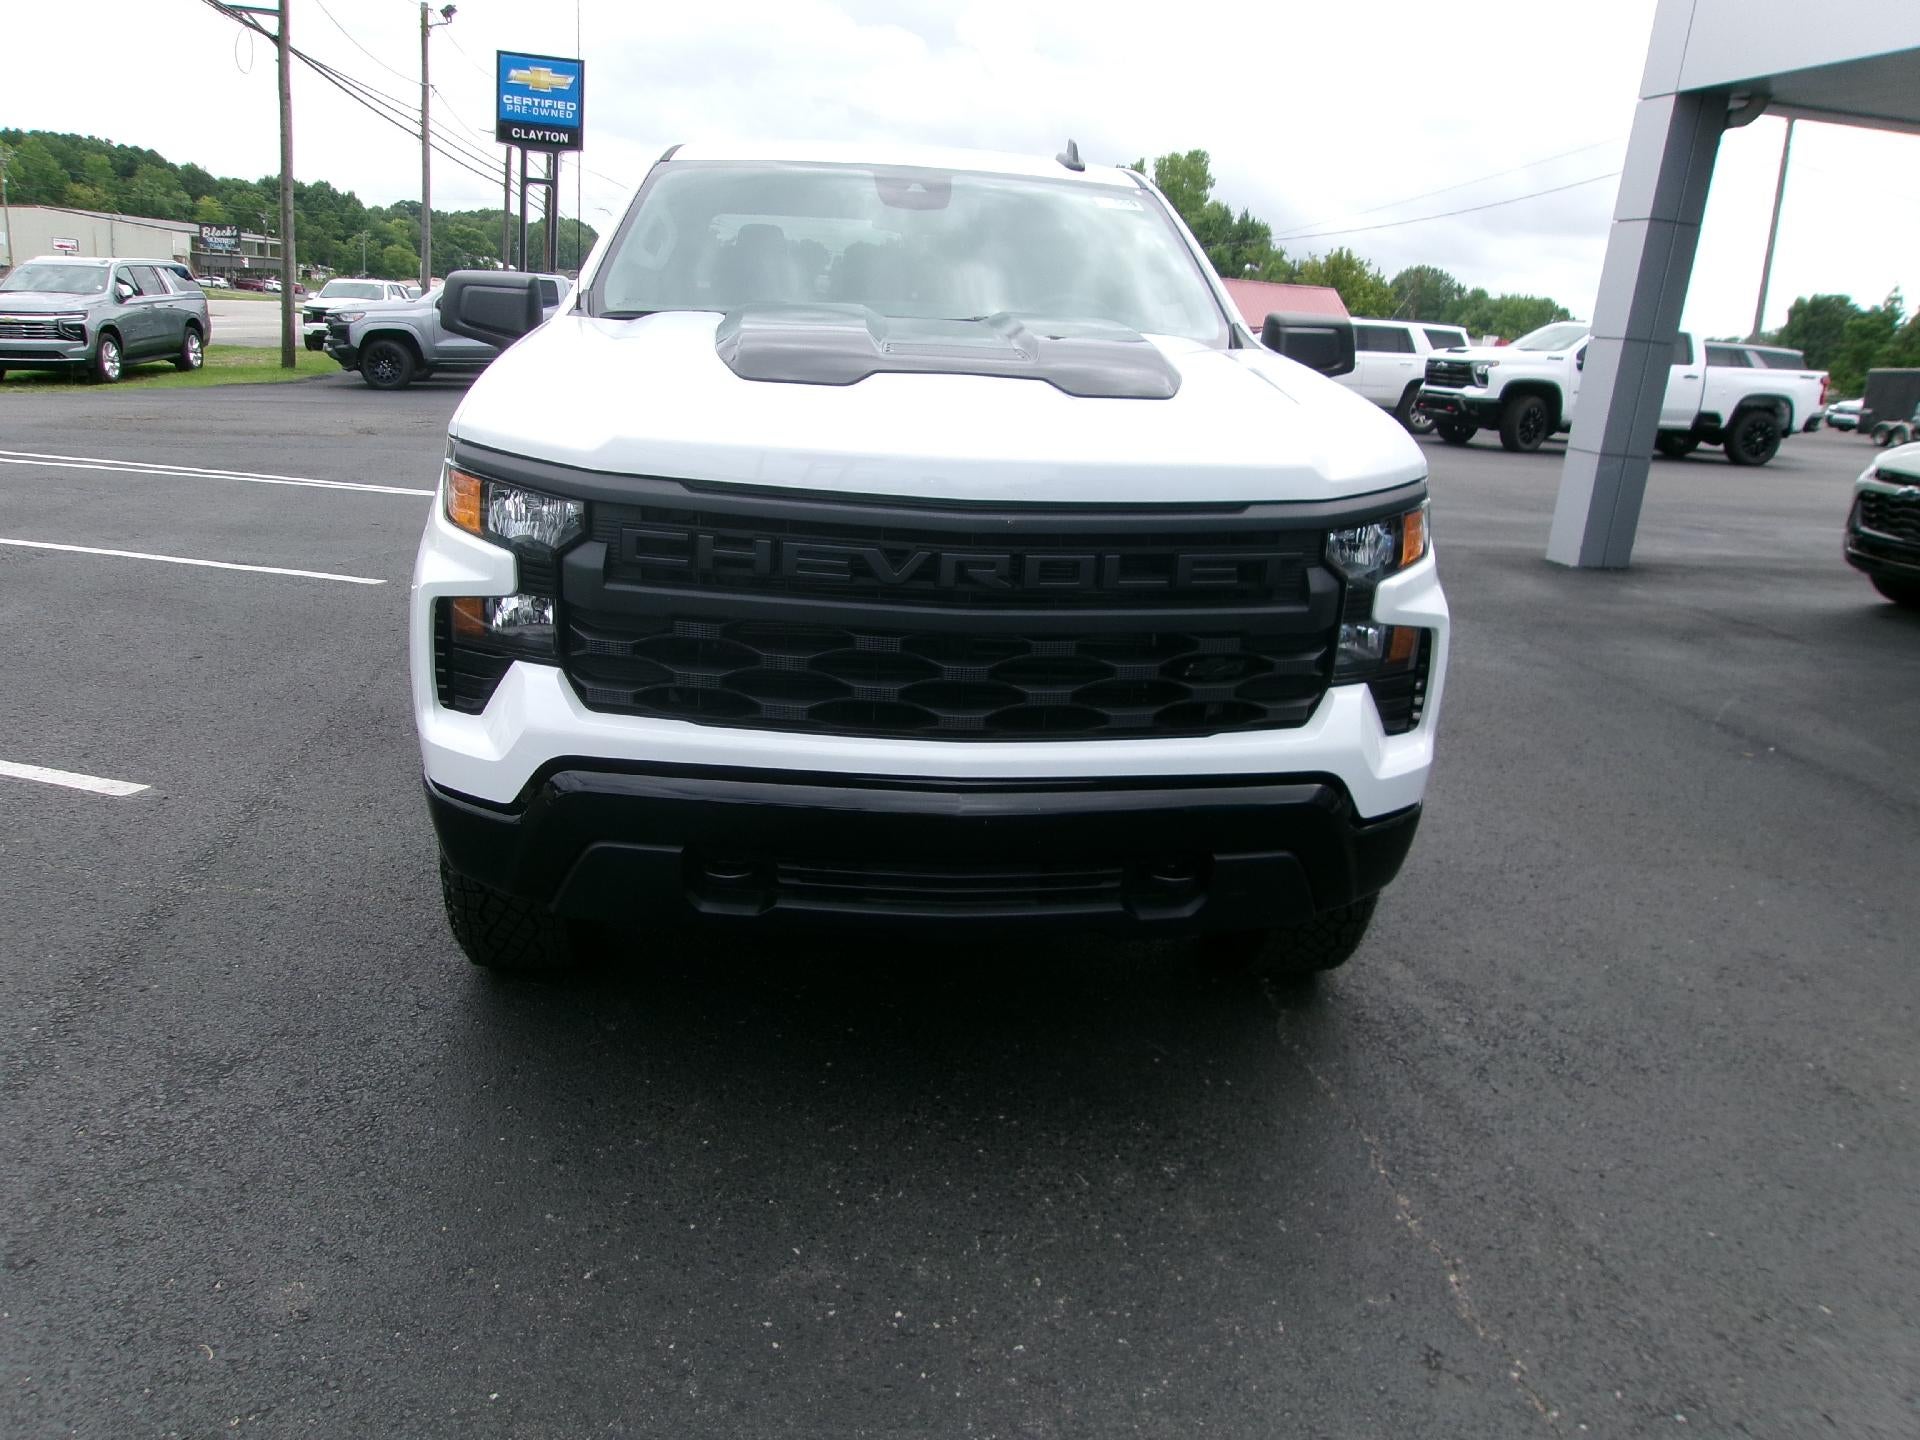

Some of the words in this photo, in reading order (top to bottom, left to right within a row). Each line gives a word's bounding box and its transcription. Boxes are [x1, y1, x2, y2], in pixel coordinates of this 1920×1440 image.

[503, 95, 576, 111] CERTIFIED
[506, 104, 573, 119] PRE-OWNED
[511, 127, 569, 143] CLAYTON
[620, 526, 1305, 589] CHEVROLET
